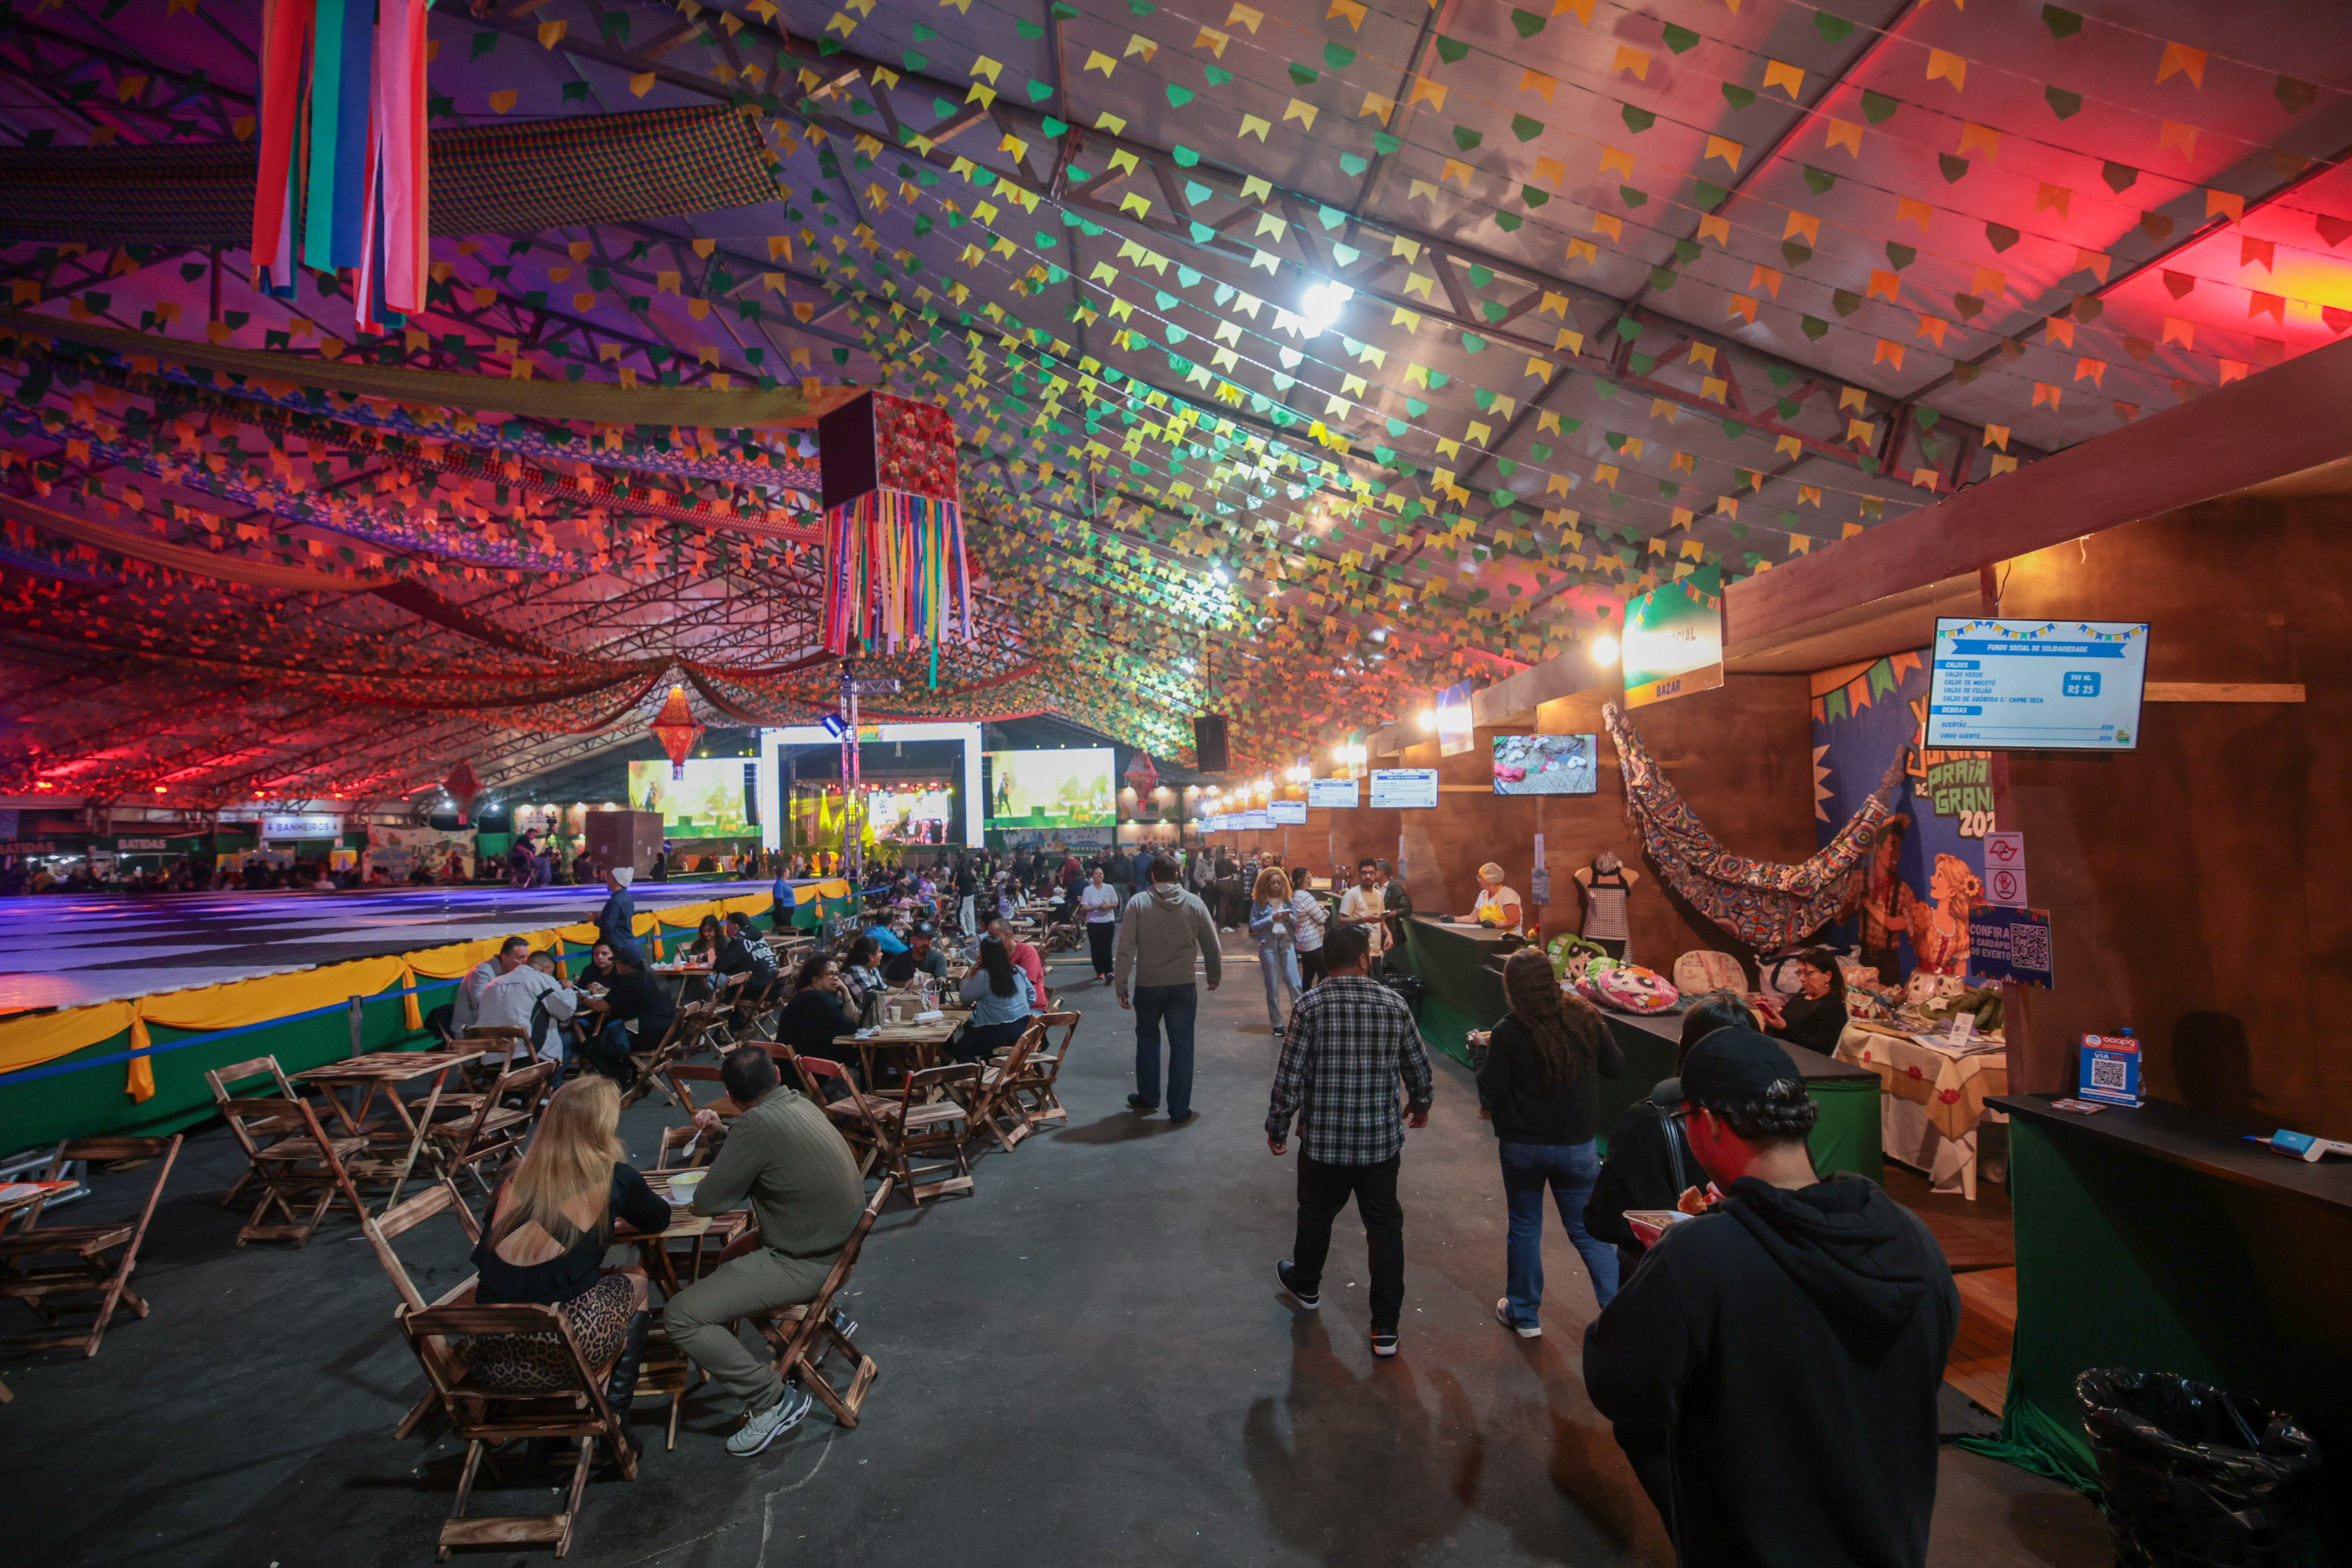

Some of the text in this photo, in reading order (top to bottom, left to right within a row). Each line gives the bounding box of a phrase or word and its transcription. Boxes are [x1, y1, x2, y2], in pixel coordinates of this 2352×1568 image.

[1657, 680, 1681, 698] BAZAR
[2067, 684, 2094, 695] R$ 25
[1935, 786, 1994, 814] GRAN
[276, 823, 330, 832] BANHEIROS
[118, 839, 166, 850] BATIDAS
[1969, 924, 2011, 940] CONFIRA
[1976, 938, 2011, 950] CARDÁPIO
[1971, 946, 2012, 961] DO EVENTO
